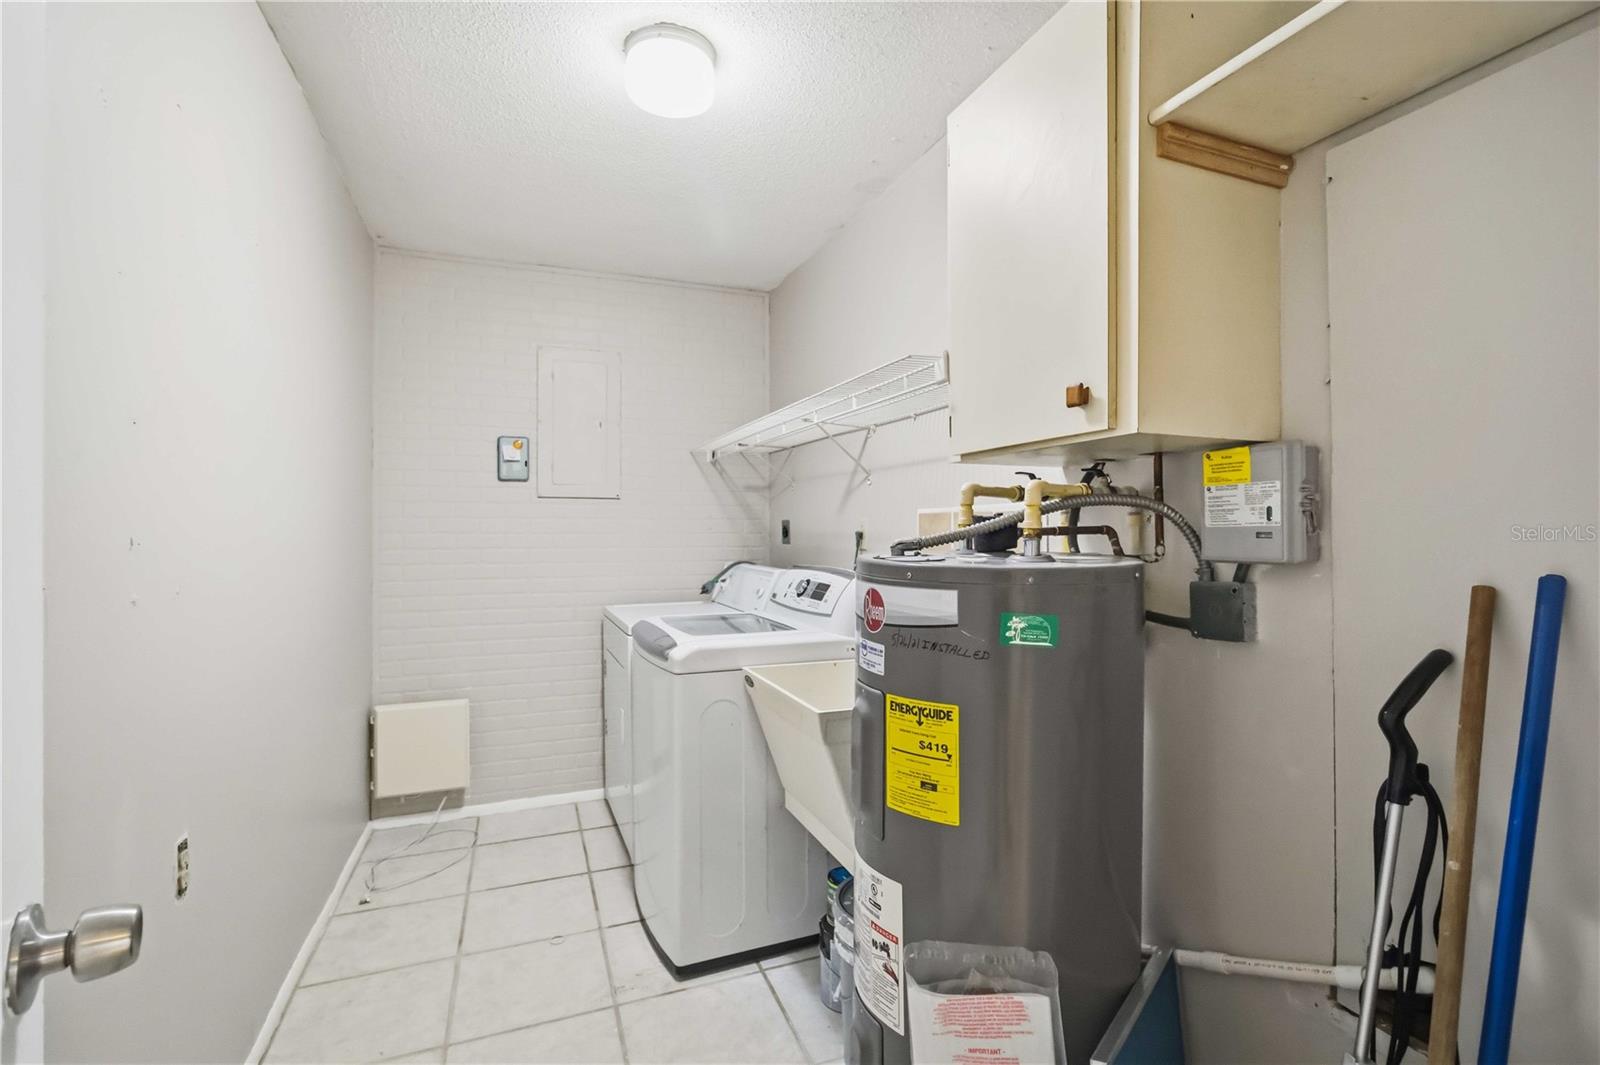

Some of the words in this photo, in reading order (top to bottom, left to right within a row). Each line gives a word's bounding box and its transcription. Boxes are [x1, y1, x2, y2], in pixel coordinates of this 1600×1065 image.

[865, 588, 884, 625] Rheem
[921, 639, 991, 661] INSTALLED
[890, 700, 954, 722] ENERGYGUIDE
[918, 740, 949, 754] $419
[967, 1047, 1002, 1056] IMPORTANT
